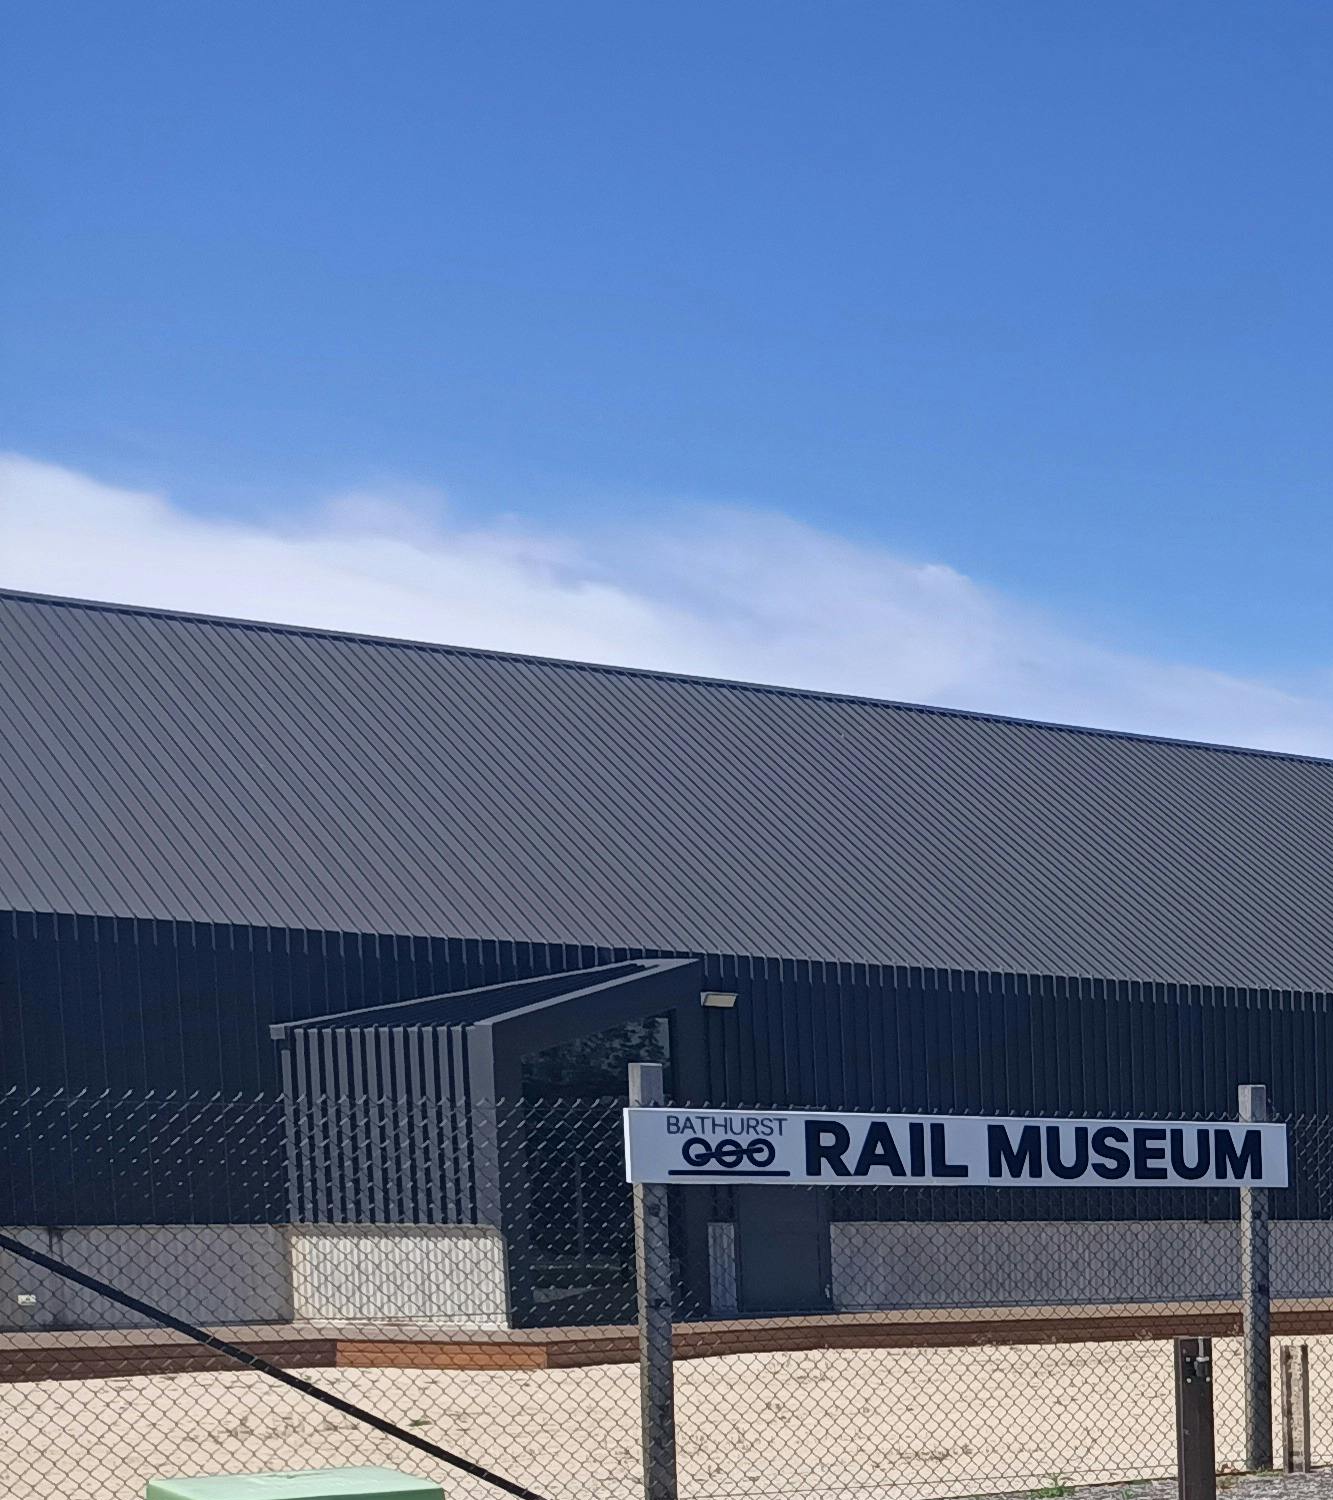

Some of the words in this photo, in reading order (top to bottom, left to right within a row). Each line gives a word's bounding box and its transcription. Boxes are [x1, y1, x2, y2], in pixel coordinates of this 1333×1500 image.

[666, 1115, 788, 1136] BATHURST
[804, 1120, 969, 1177] RAIL
[987, 1124, 1263, 1180] MUSEUM
